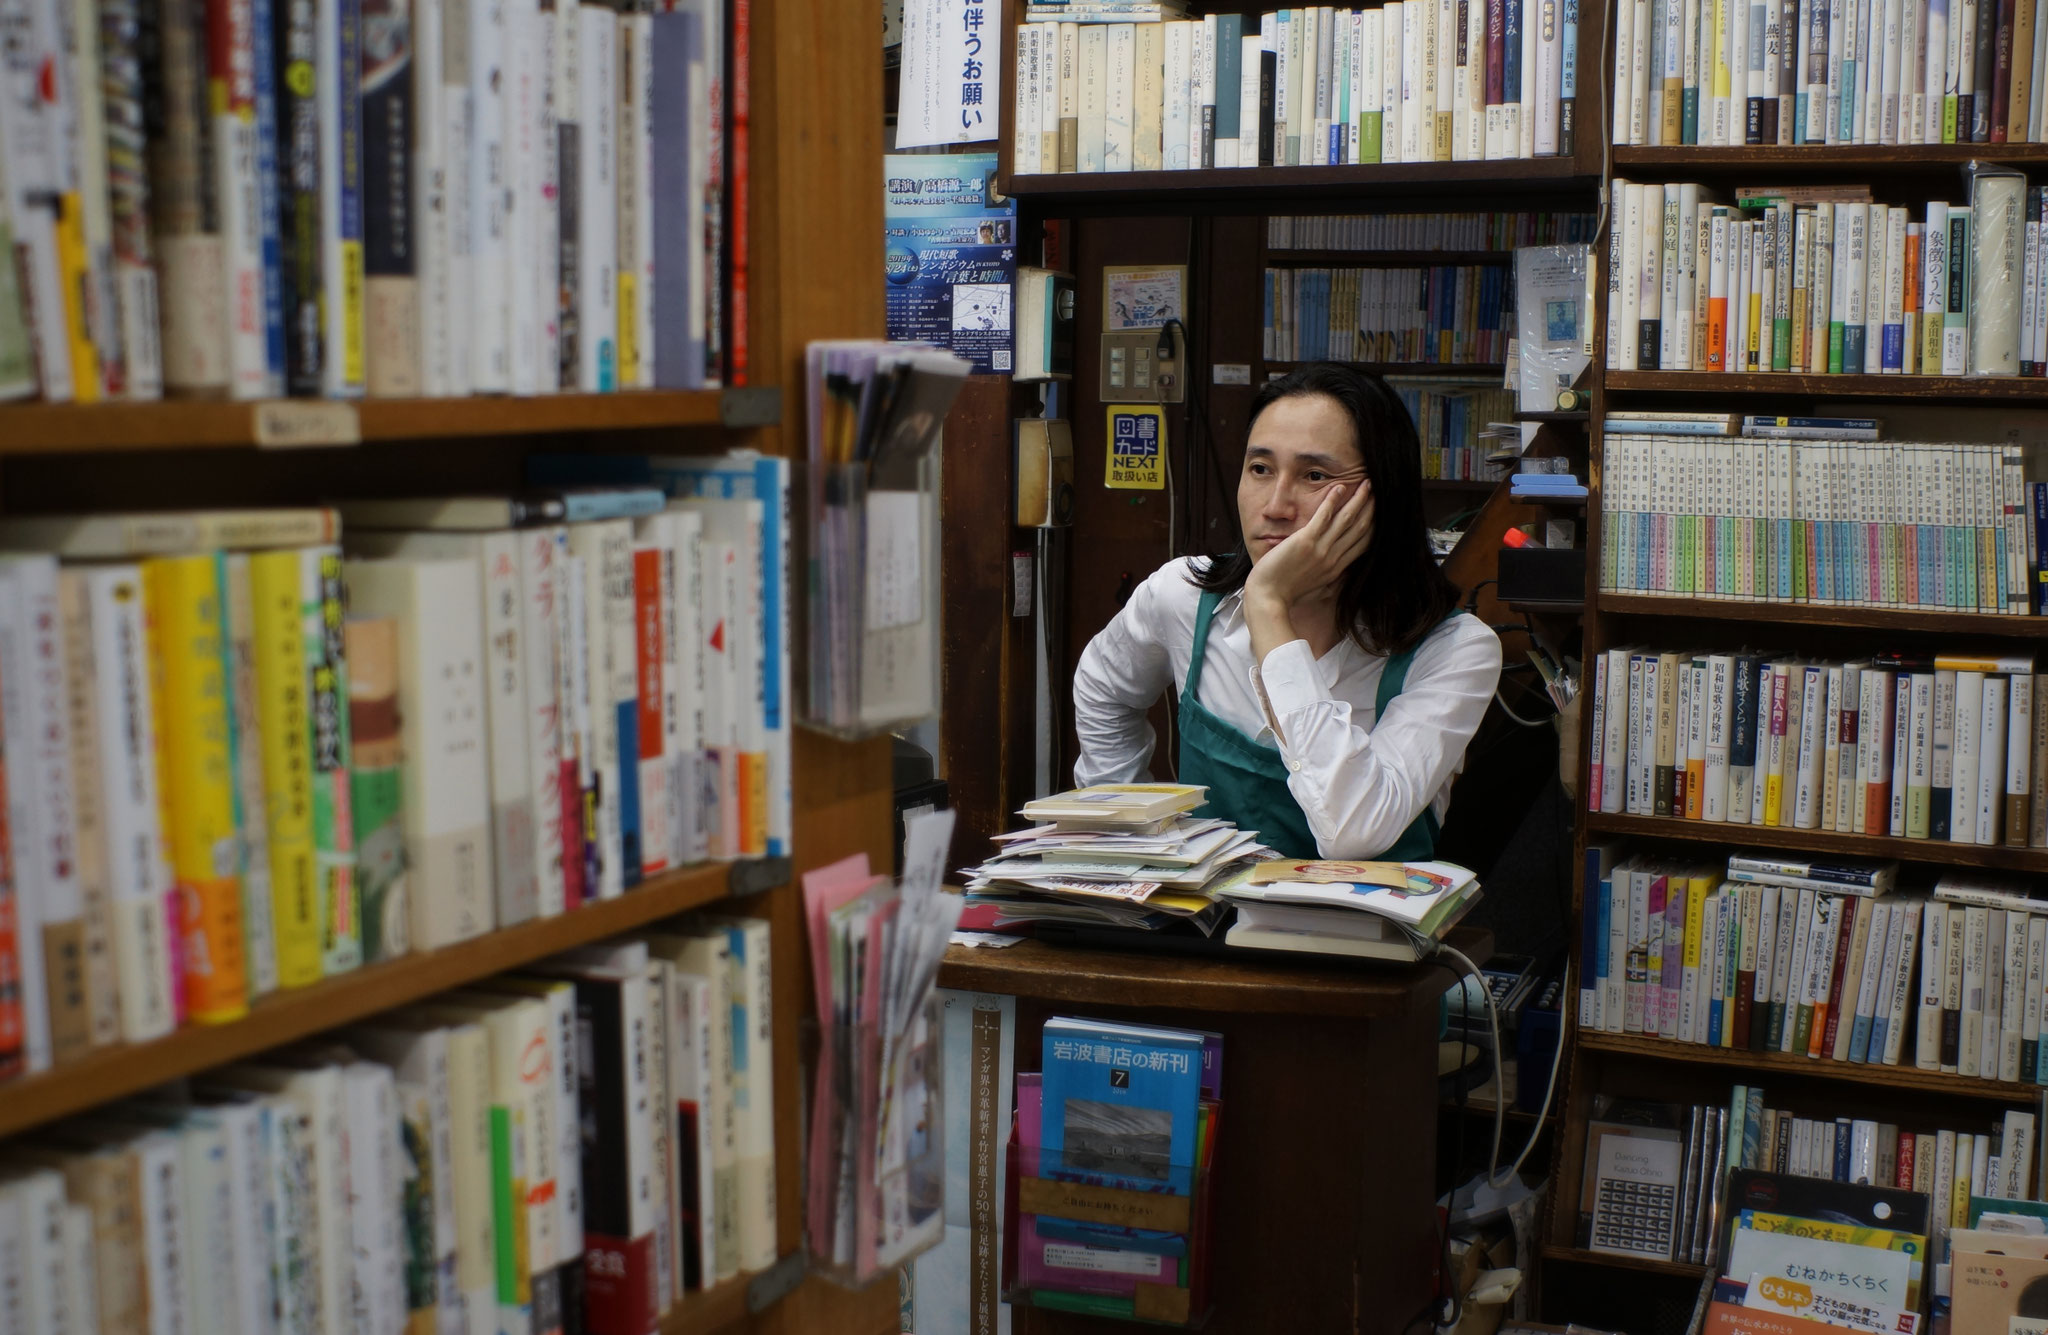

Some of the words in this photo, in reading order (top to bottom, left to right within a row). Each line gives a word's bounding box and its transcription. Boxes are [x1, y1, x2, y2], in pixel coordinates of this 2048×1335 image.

[961, 0, 984, 129] 伴うお願い
[1664, 200, 1678, 251] 午後の庭
[1682, 216, 1694, 266] 某月某日
[1699, 221, 1709, 257] 後の日々
[1714, 218, 1723, 264] 生命の内と外
[1851, 215, 1864, 261] 新樹滴滴
[919, 249, 959, 261] 現代短歌
[1870, 210, 1882, 280] もうすぐ夏至だ
[919, 260, 976, 271] シンポジウム
[1928, 230, 1945, 306] 象徴のうた
[1113, 456, 1158, 469] NEXT
[1115, 439, 1157, 457] カード
[1112, 470, 1159, 483] 取扱い店
[1710, 662, 1725, 744] 昭和短歌の再検討
[1773, 676, 1786, 722] 短歌入門
[1829, 677, 1840, 718] わが心の歌
[1629, 674, 1640, 767] 短歌のための文語文法入門
[1644, 706, 1654, 738] 短歌入門
[2011, 924, 2026, 969] 夏は来ぬ
[1052, 1040, 1190, 1075] 岩波書店の新刊
[1114, 1072, 1125, 1086] 7
[1614, 1164, 1636, 1174] Kazuo
[1639, 1167, 1663, 1178] Ohno
[1615, 1151, 1649, 1164] Dancing
[1062, 1195, 1153, 1216] ご自由にお持ちください
[1785, 1262, 1889, 1294] むねがちくちく
[1813, 1294, 1881, 1319] 子どもの脳が育つ
